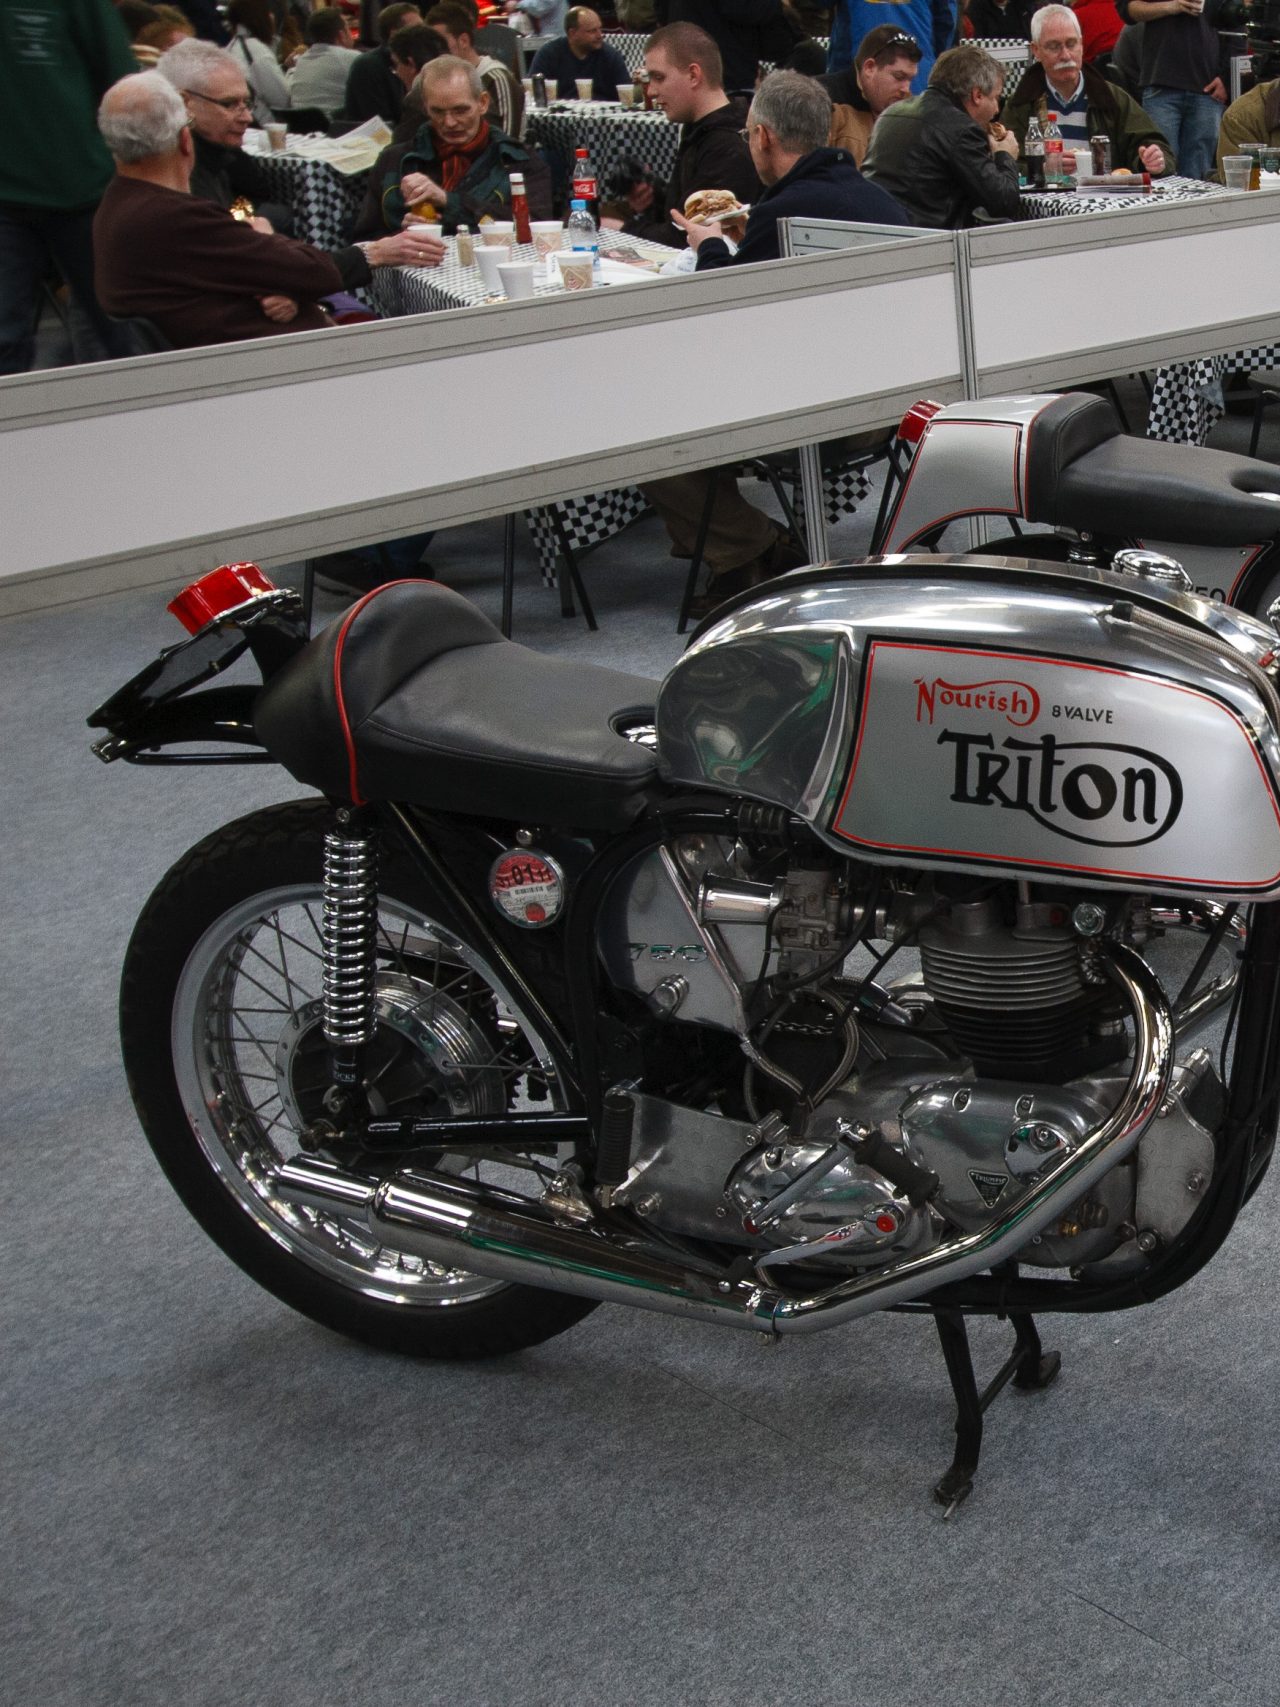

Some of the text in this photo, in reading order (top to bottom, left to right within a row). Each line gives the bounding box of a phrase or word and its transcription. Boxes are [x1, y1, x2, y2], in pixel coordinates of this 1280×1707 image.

[913, 677, 1113, 727] Nourish 8 VALVE
